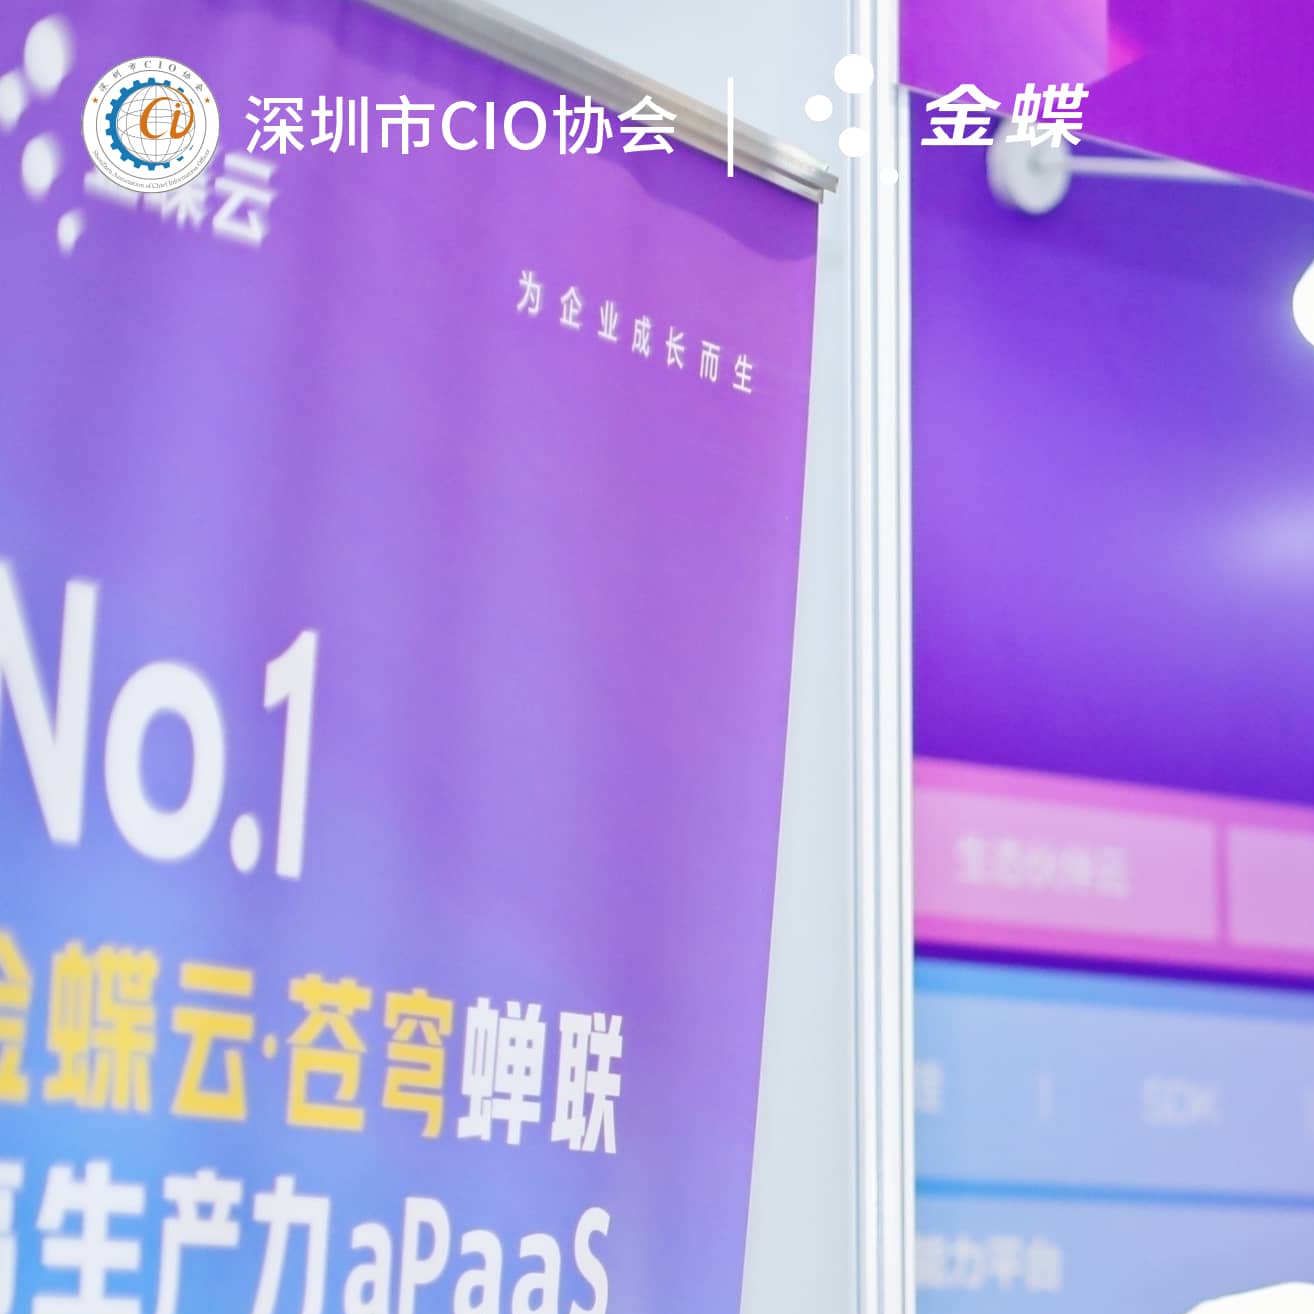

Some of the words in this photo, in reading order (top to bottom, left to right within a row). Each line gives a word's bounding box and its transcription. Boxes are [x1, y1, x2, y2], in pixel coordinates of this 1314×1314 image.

[516, 269, 755, 395] 为企业成长而生
[0, 551, 319, 881] No.1
